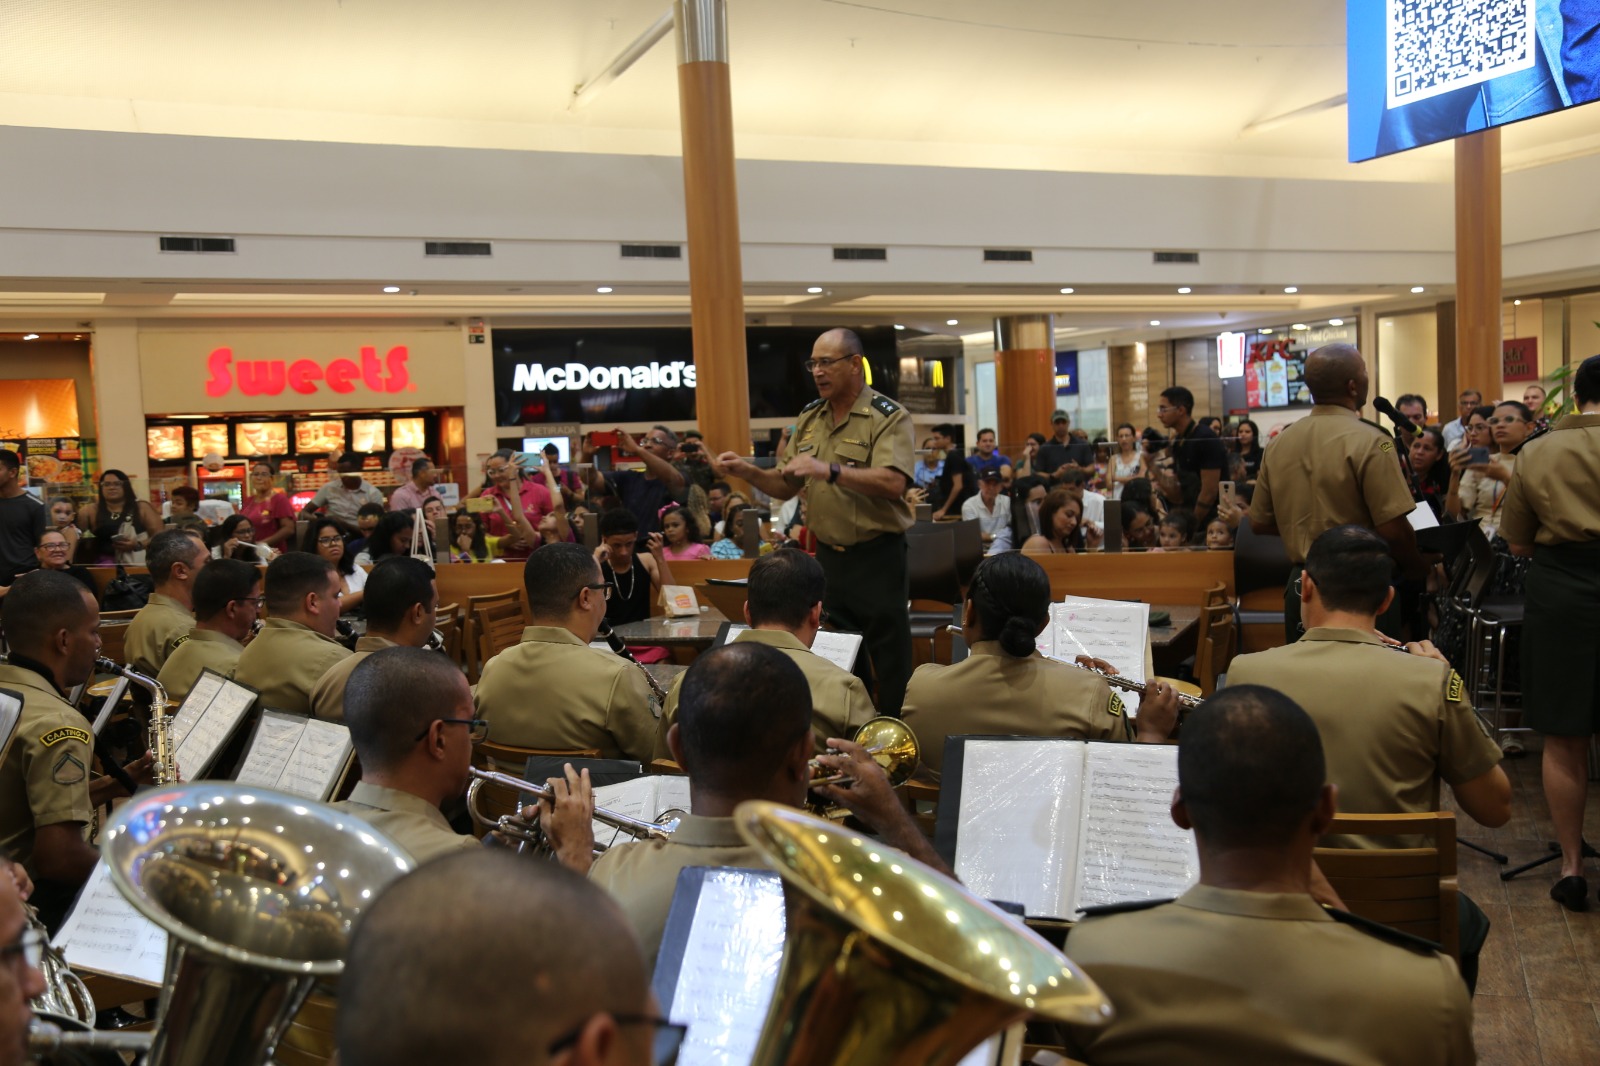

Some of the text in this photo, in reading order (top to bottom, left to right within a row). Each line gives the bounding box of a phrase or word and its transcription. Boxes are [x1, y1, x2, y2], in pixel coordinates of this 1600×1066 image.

[1248, 338, 1296, 363] KFC
[513, 361, 697, 391] McDonald's
[530, 426, 576, 434] RETIRADA
[46, 729, 86, 741] CAATINGA
